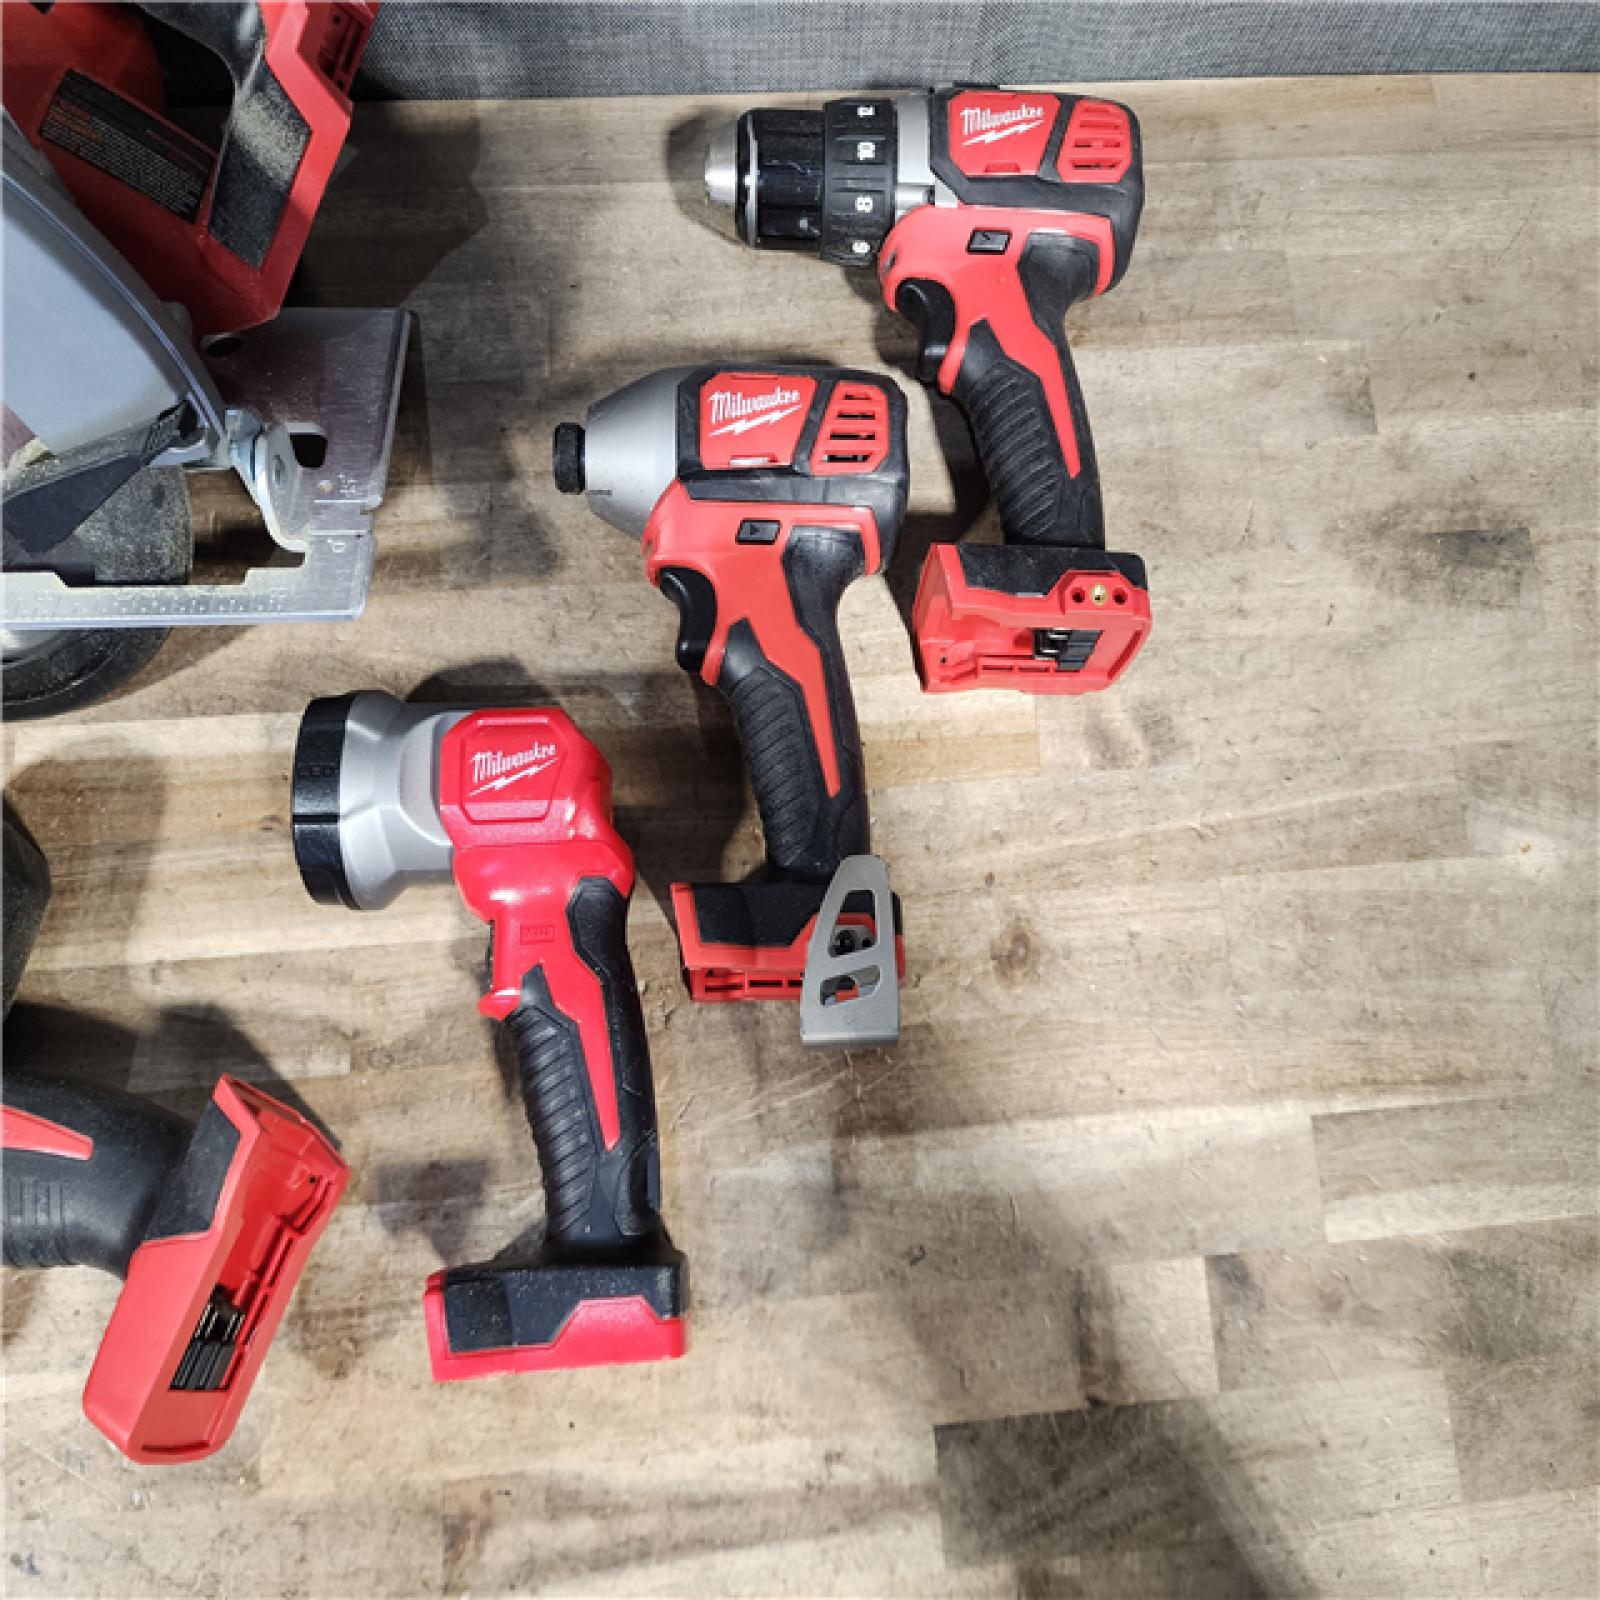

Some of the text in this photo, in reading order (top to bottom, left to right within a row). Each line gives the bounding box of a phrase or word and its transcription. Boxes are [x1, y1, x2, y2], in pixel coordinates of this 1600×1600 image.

[960, 103, 1042, 136] Milwaukee
[855, 195, 873, 213] 8
[708, 387, 801, 425] Milwaukee
[470, 741, 556, 784] Milwaukee
